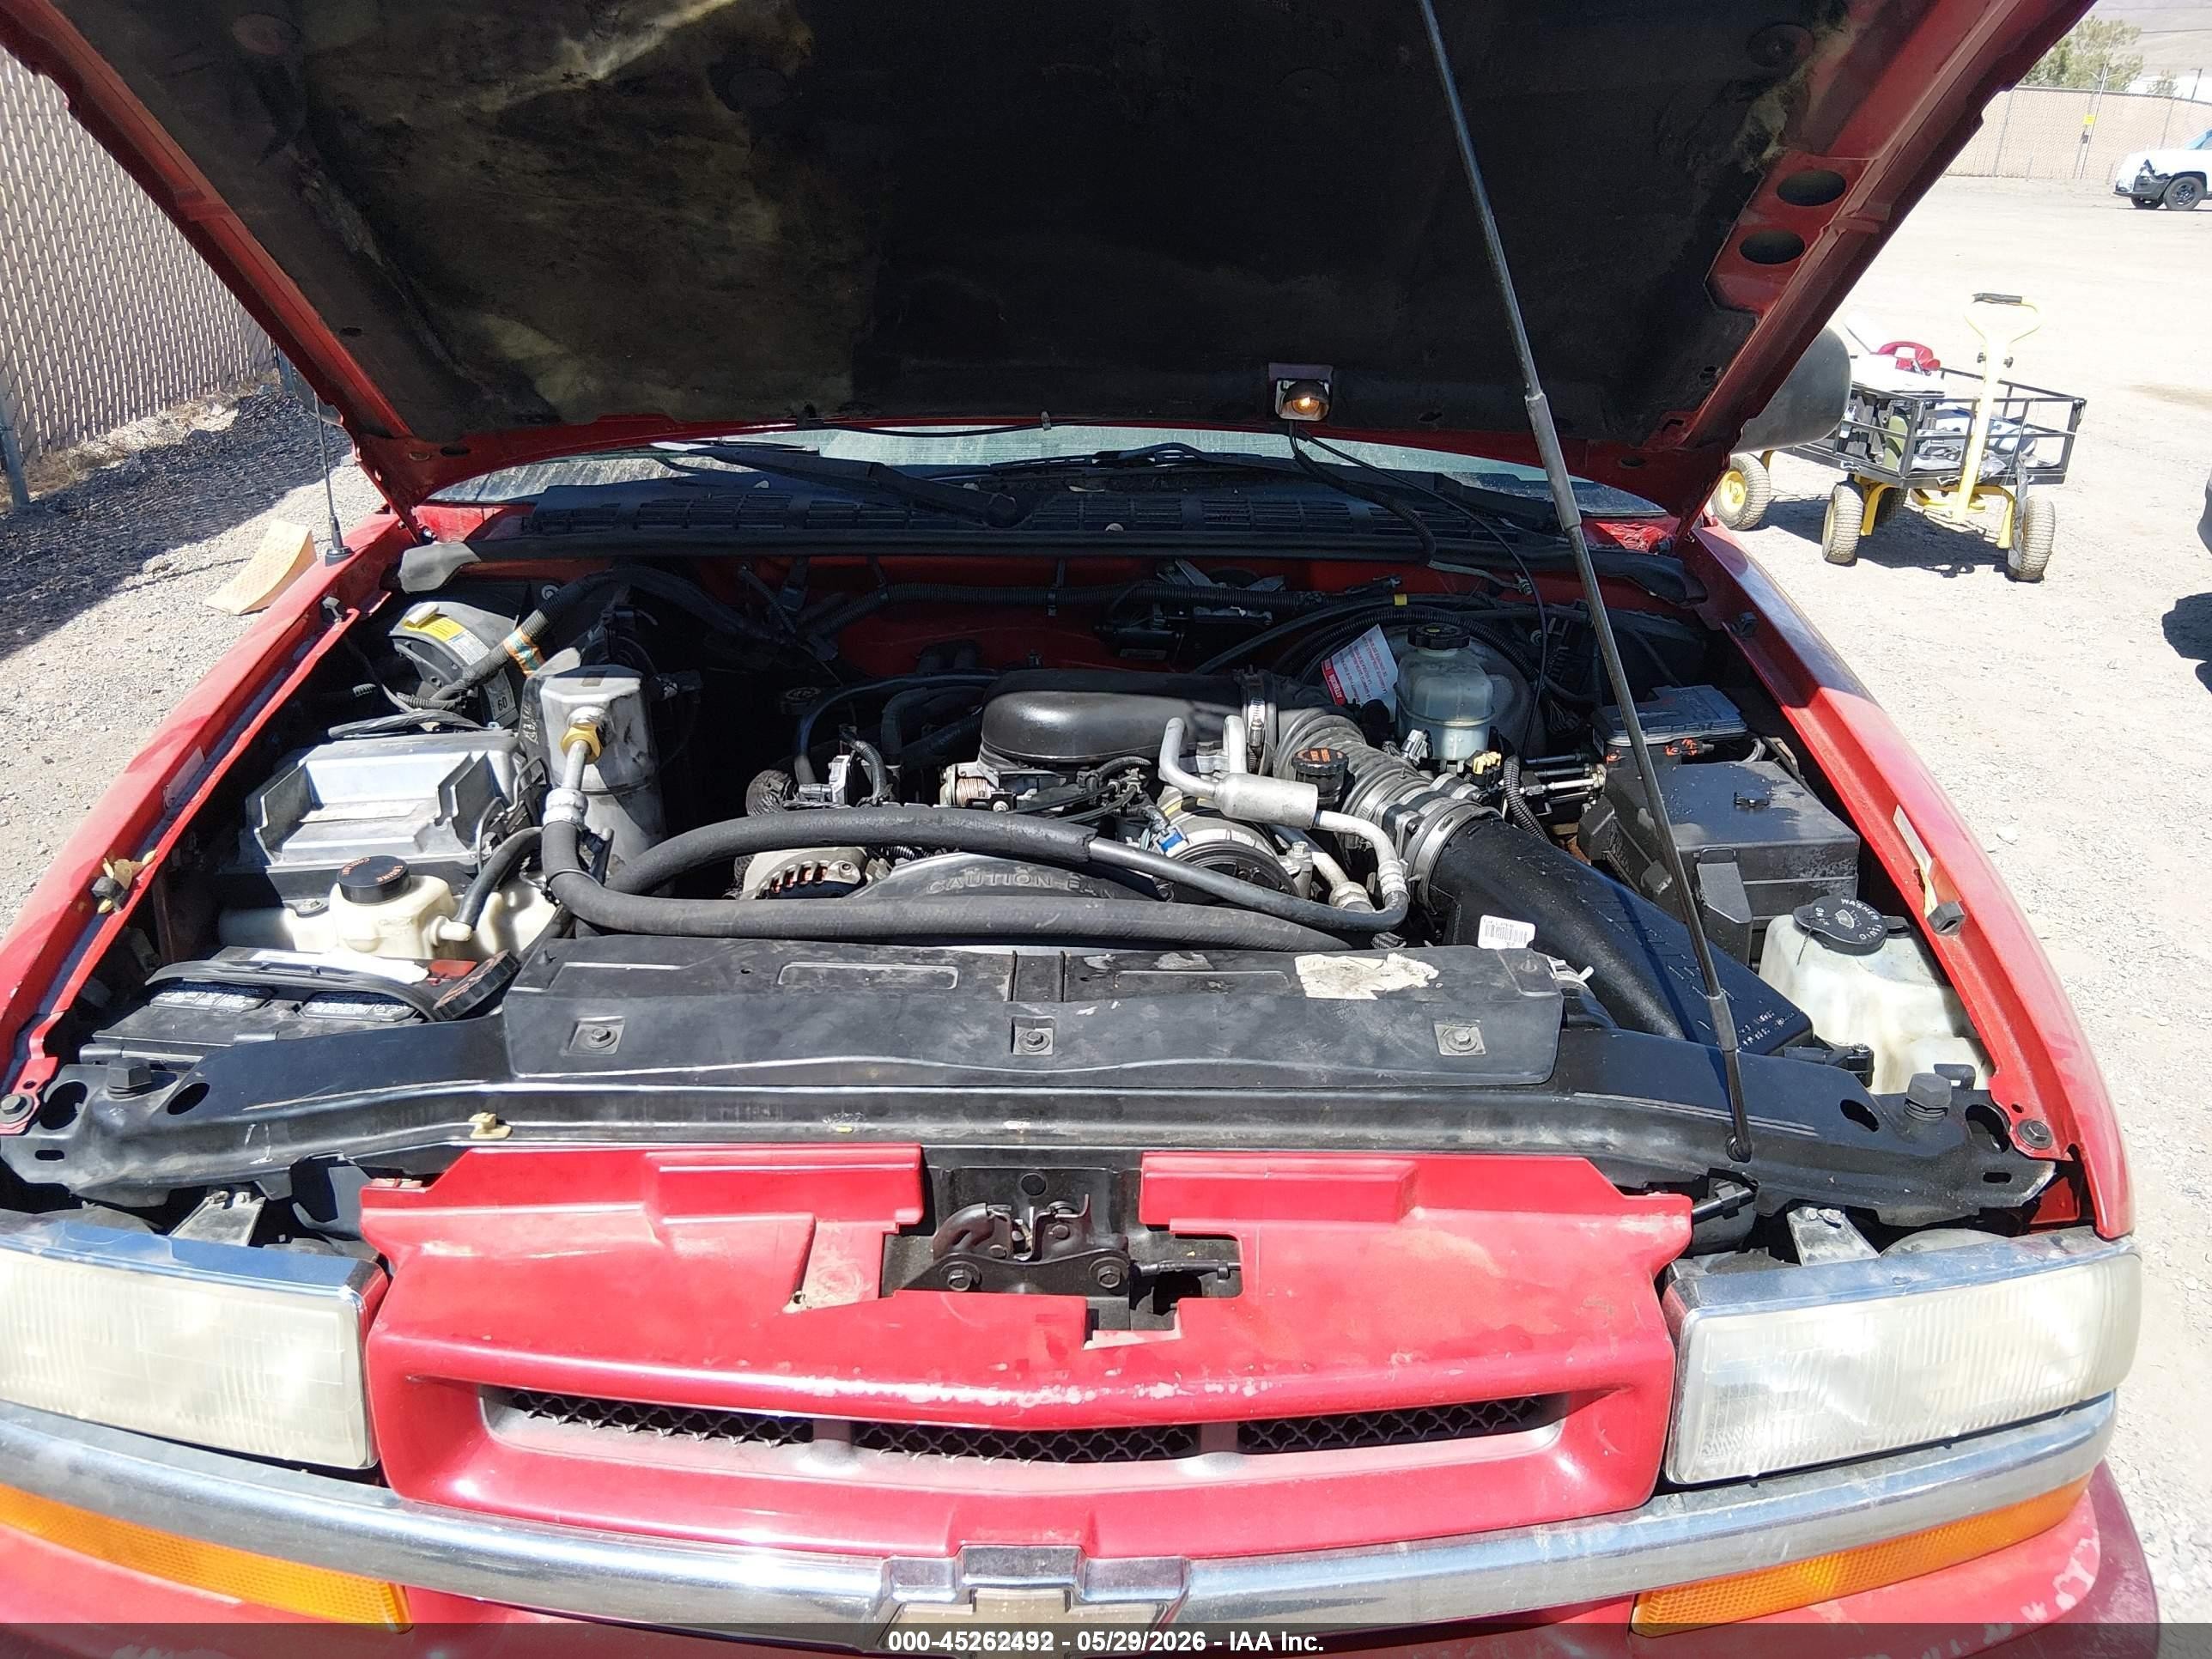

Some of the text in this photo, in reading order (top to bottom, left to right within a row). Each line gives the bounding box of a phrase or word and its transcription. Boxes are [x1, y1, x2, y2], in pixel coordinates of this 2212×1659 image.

[497, 696, 508, 711] 60
[927, 871, 1053, 894] CAUTION
[1840, 898, 1880, 921] WASHER
